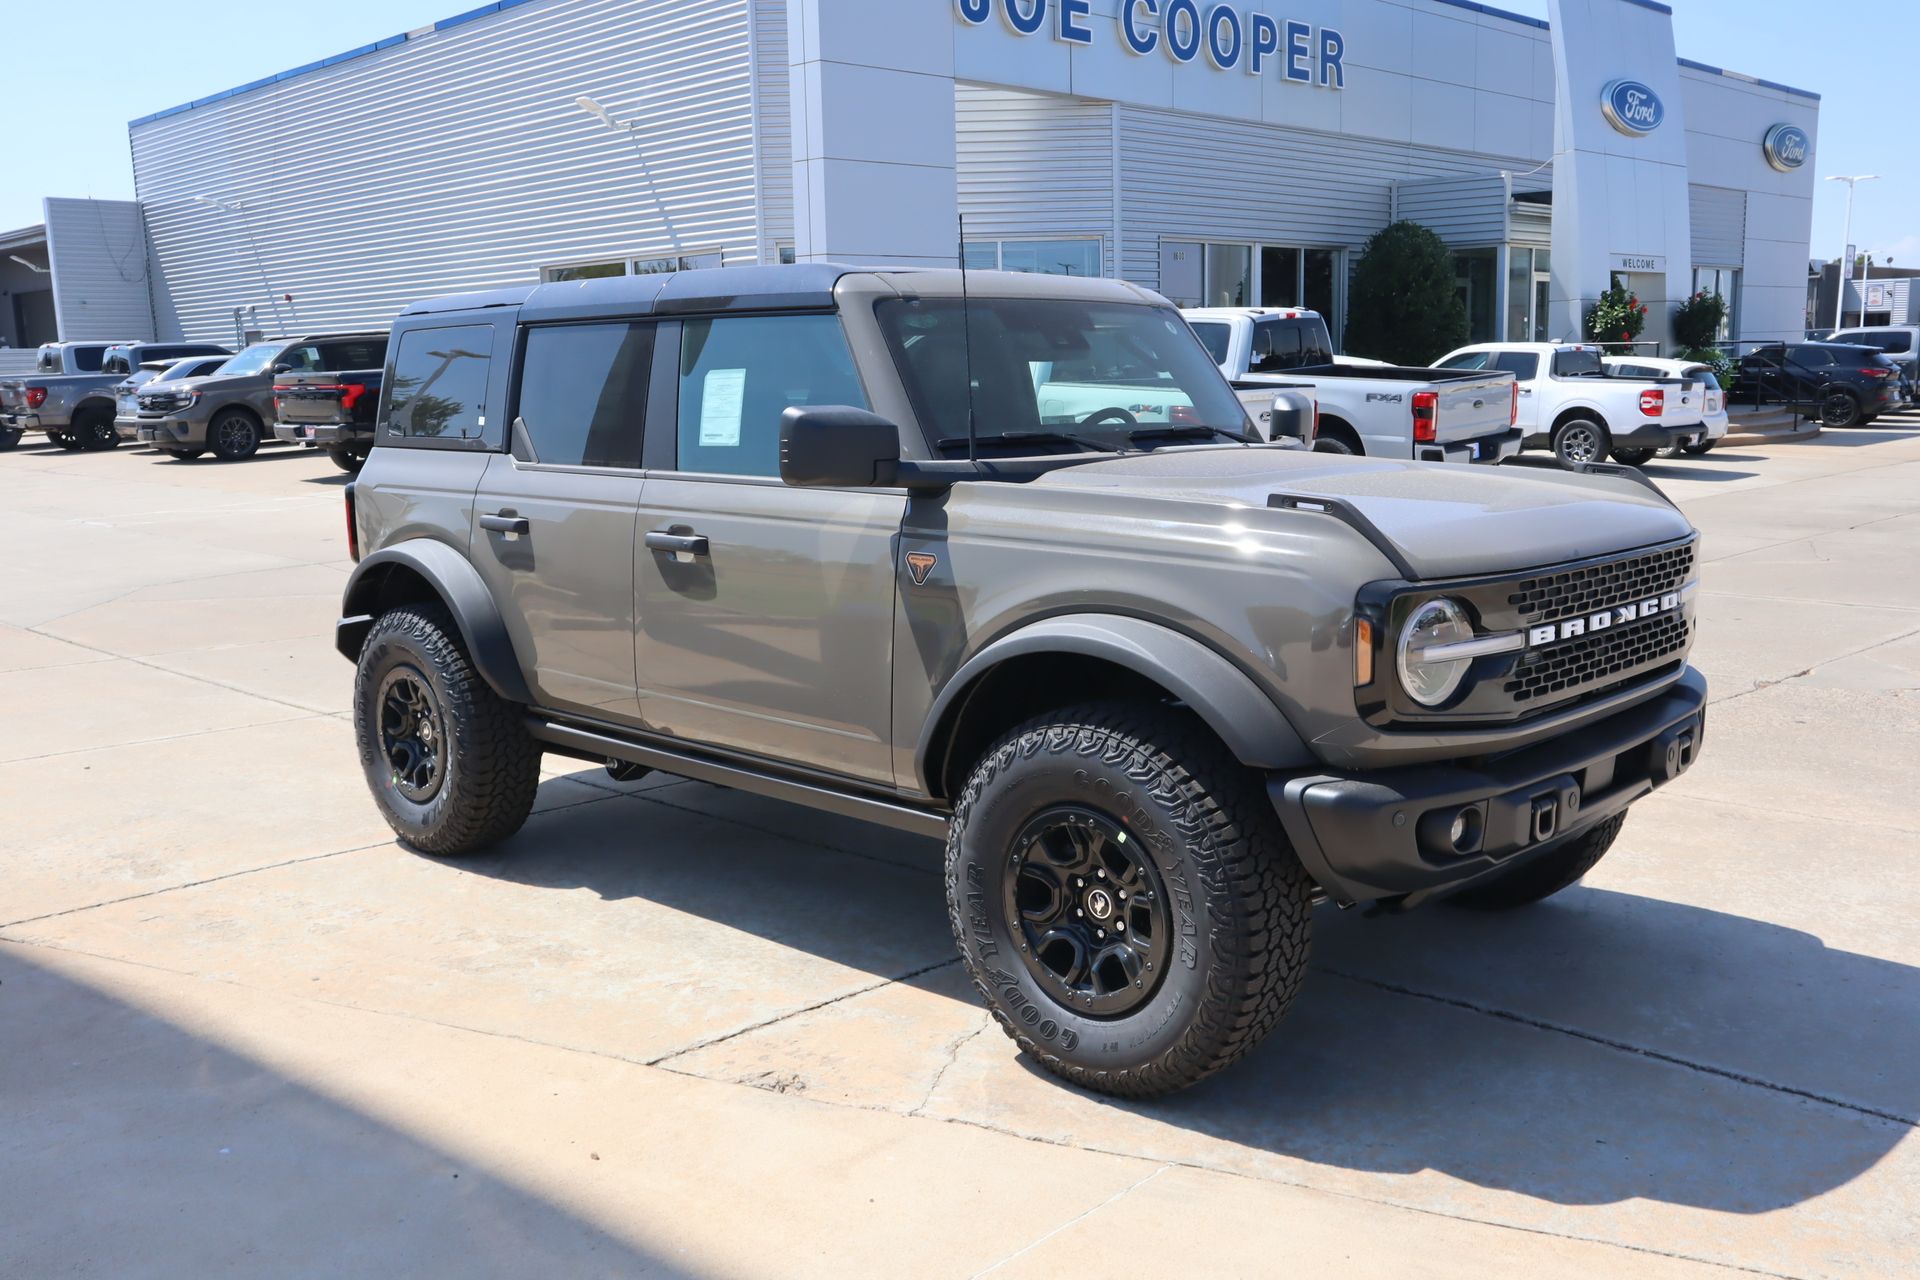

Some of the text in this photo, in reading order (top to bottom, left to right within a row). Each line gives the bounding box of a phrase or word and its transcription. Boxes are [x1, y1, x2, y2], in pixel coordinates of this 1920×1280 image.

[1117, 0, 1345, 89] COOPER
[1624, 89, 1656, 123] Ford
[1782, 133, 1806, 160] Ford
[1622, 258, 1655, 270] WELCOME
[1365, 392, 1403, 403] FX4
[1529, 591, 1680, 646] BRONCO
